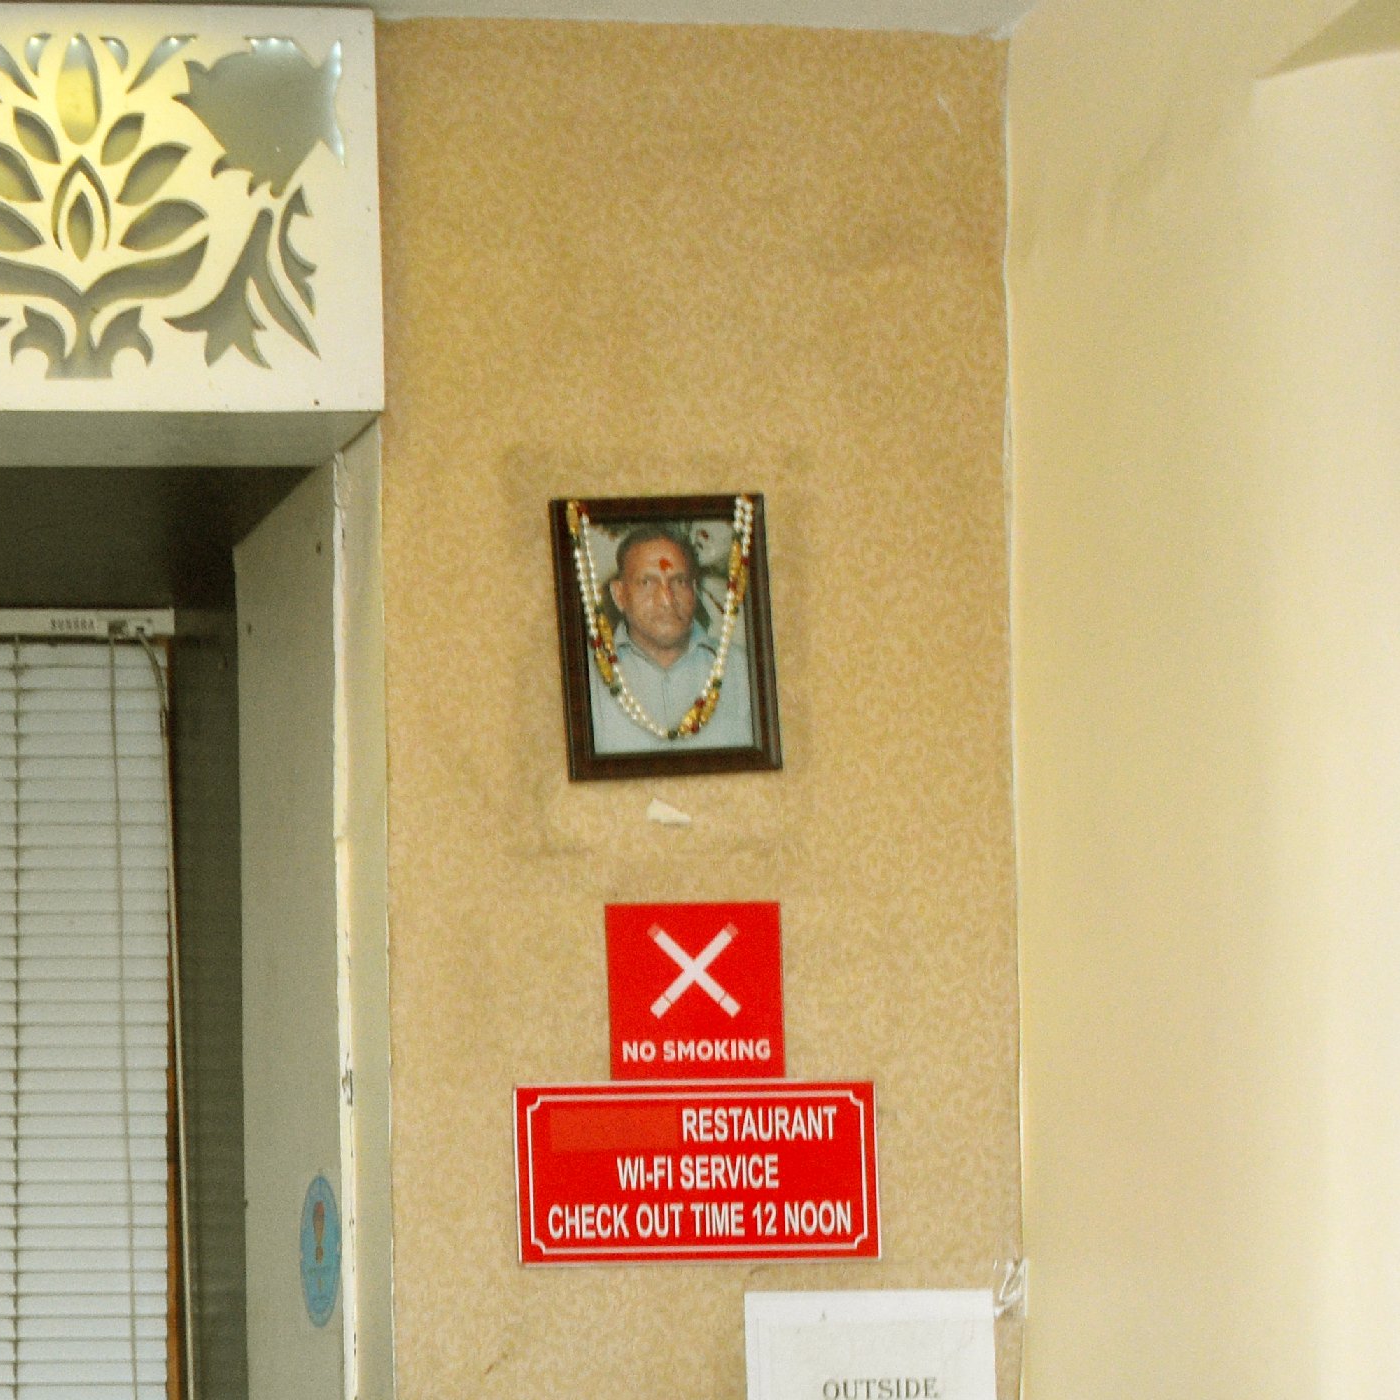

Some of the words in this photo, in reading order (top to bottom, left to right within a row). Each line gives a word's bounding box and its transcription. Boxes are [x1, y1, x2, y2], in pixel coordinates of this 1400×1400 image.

[622, 1040, 656, 1062] NO
[662, 1038, 771, 1062] SMOKING
[682, 1106, 838, 1142] RESTAURANT
[617, 1156, 674, 1191] WI-FI
[679, 1153, 779, 1190] SERVICE
[547, 1204, 629, 1240] CHECK
[635, 1203, 683, 1239] OUT
[691, 1202, 745, 1237] TIME
[753, 1202, 778, 1236] 12
[783, 1200, 852, 1235] NOON
[822, 1377, 939, 1400] OUTSIDE
